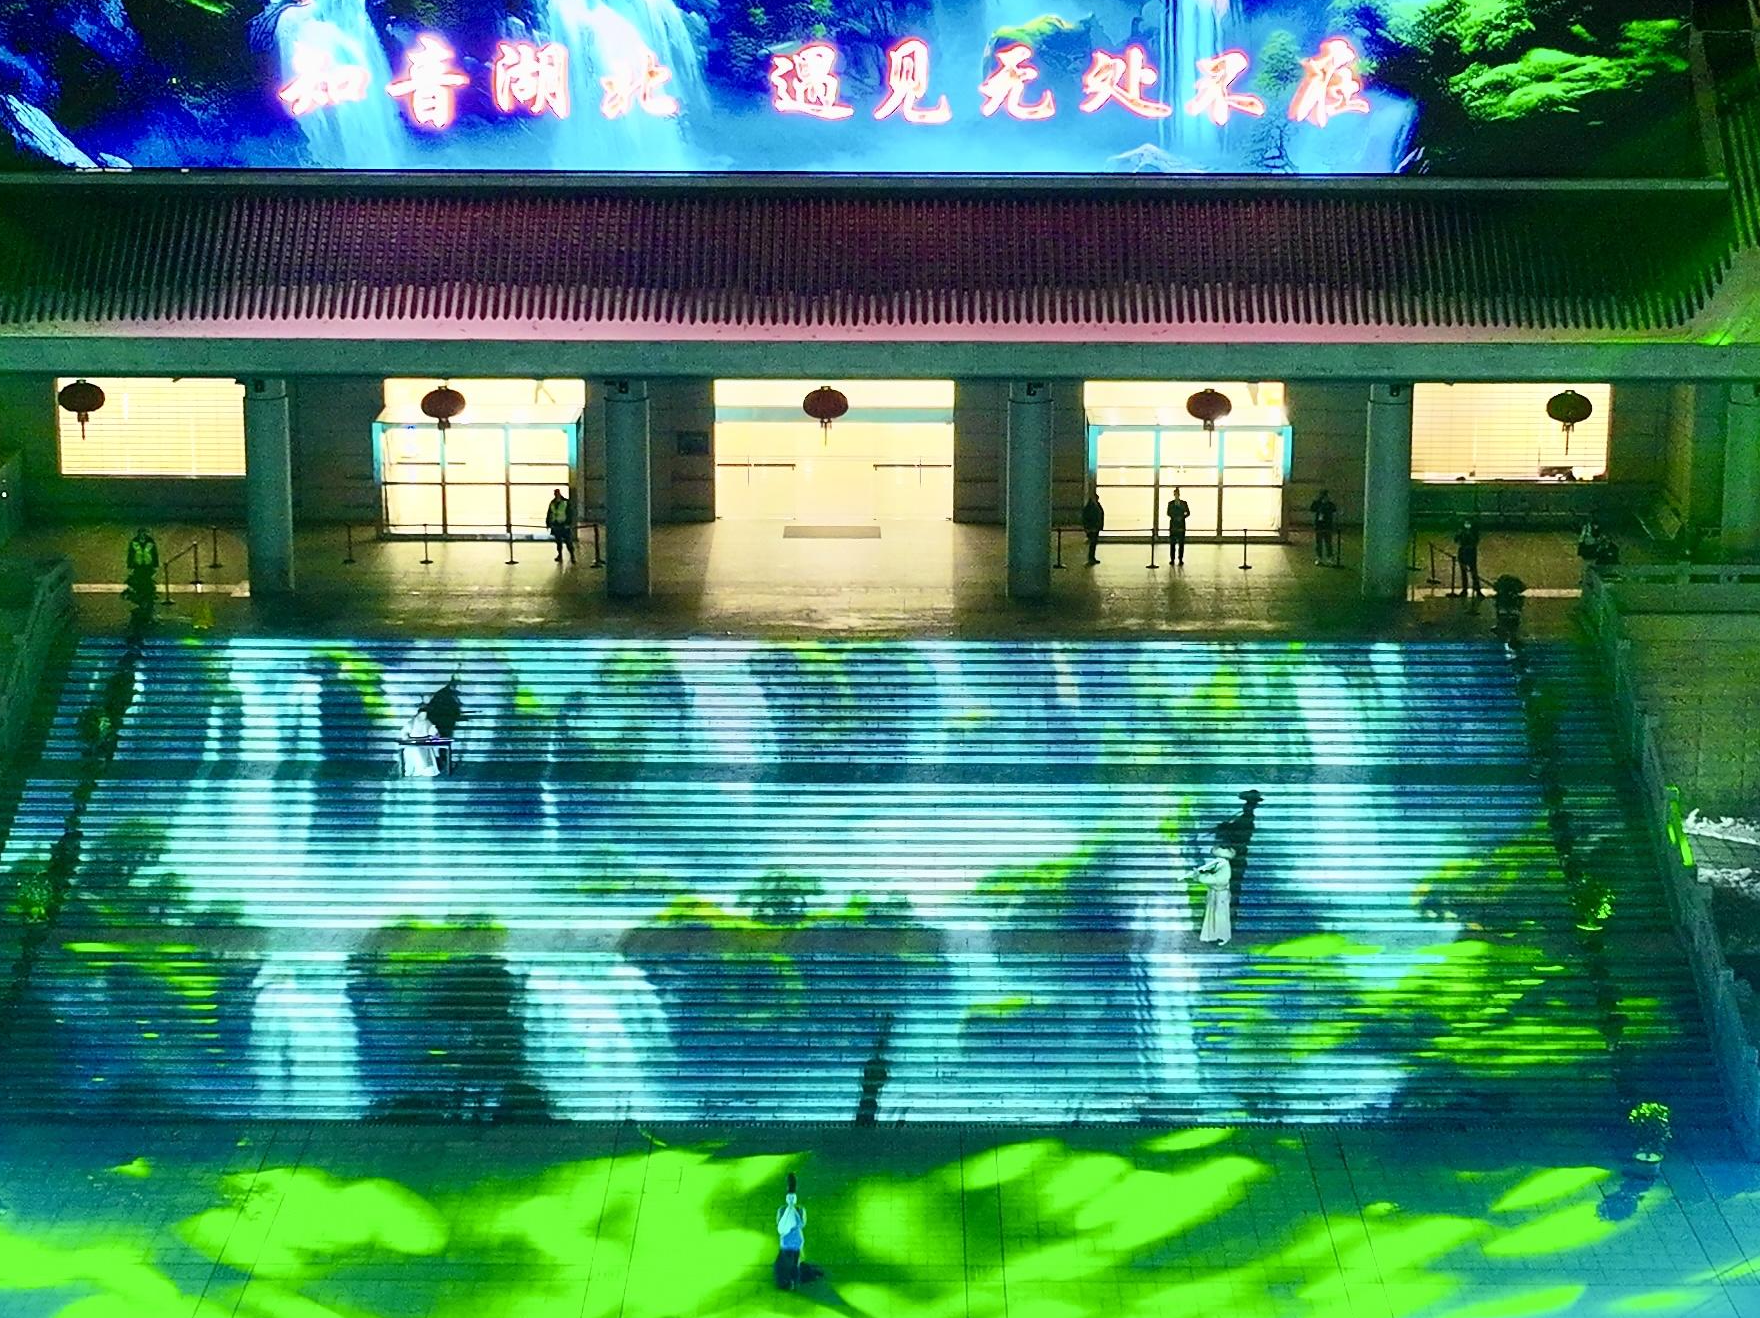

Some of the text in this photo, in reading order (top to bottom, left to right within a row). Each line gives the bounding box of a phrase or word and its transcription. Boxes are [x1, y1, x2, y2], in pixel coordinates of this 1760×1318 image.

[278, 34, 1371, 128] 知音湖北 遇见无处不在
